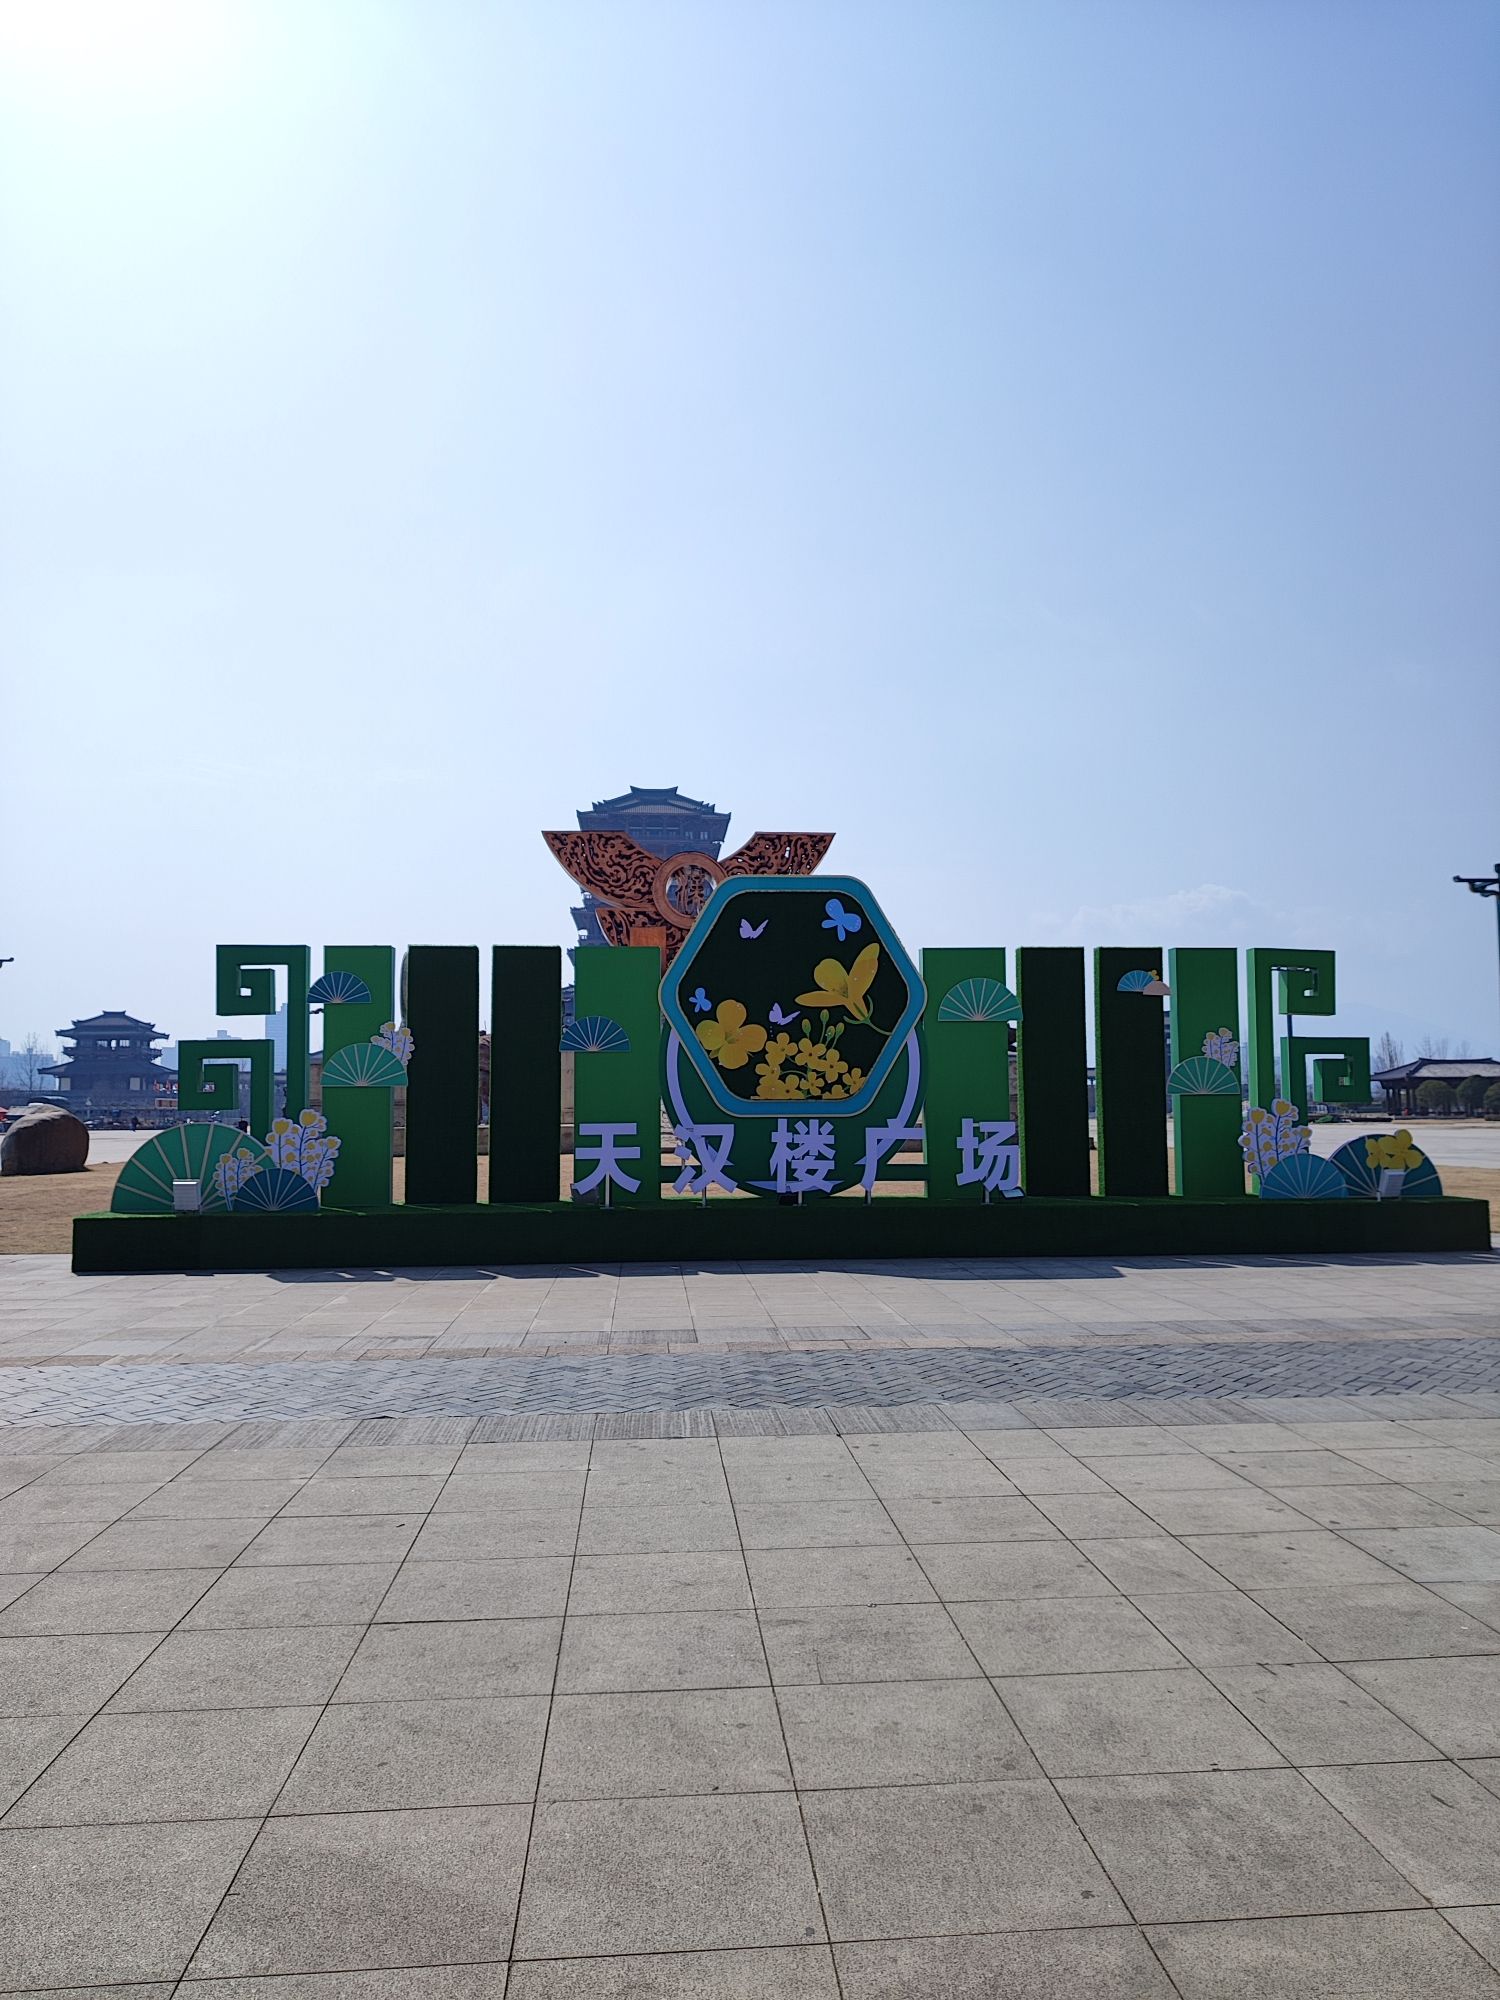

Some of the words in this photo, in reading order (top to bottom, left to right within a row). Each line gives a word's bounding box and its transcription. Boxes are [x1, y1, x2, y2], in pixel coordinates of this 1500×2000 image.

[573, 1118, 1020, 1194] 天汉楼广场
